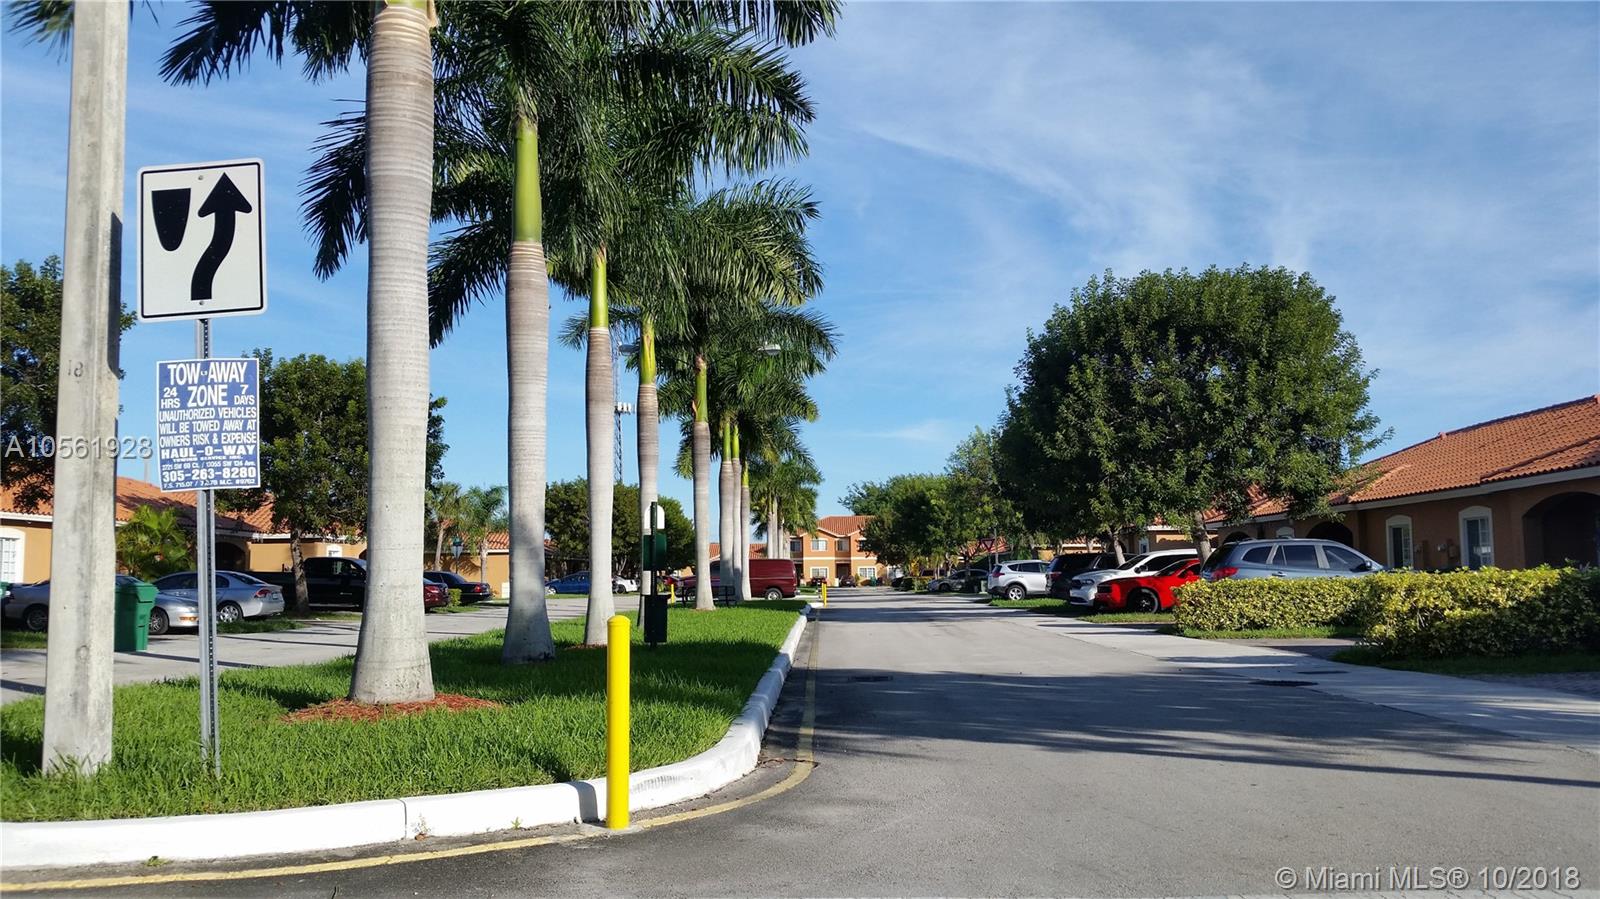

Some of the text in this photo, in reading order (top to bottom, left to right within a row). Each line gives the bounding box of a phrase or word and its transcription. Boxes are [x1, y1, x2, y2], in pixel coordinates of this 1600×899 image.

[167, 362, 248, 385] TOW-AWAY
[164, 387, 178, 398] 24
[187, 384, 228, 407] ZONE
[240, 384, 248, 394] 7
[161, 398, 180, 408] HRS
[234, 395, 255, 405] DAYS
[160, 407, 256, 422] UNAUTHORIZED VEHICLES
[160, 419, 256, 434] WILL BE TOWED AWAY AT
[160, 432, 256, 448] OWNERS RISK & EXPENSE
[161, 444, 256, 459] HAUL-O-WAY
[162, 467, 256, 482] 305-263-8280
